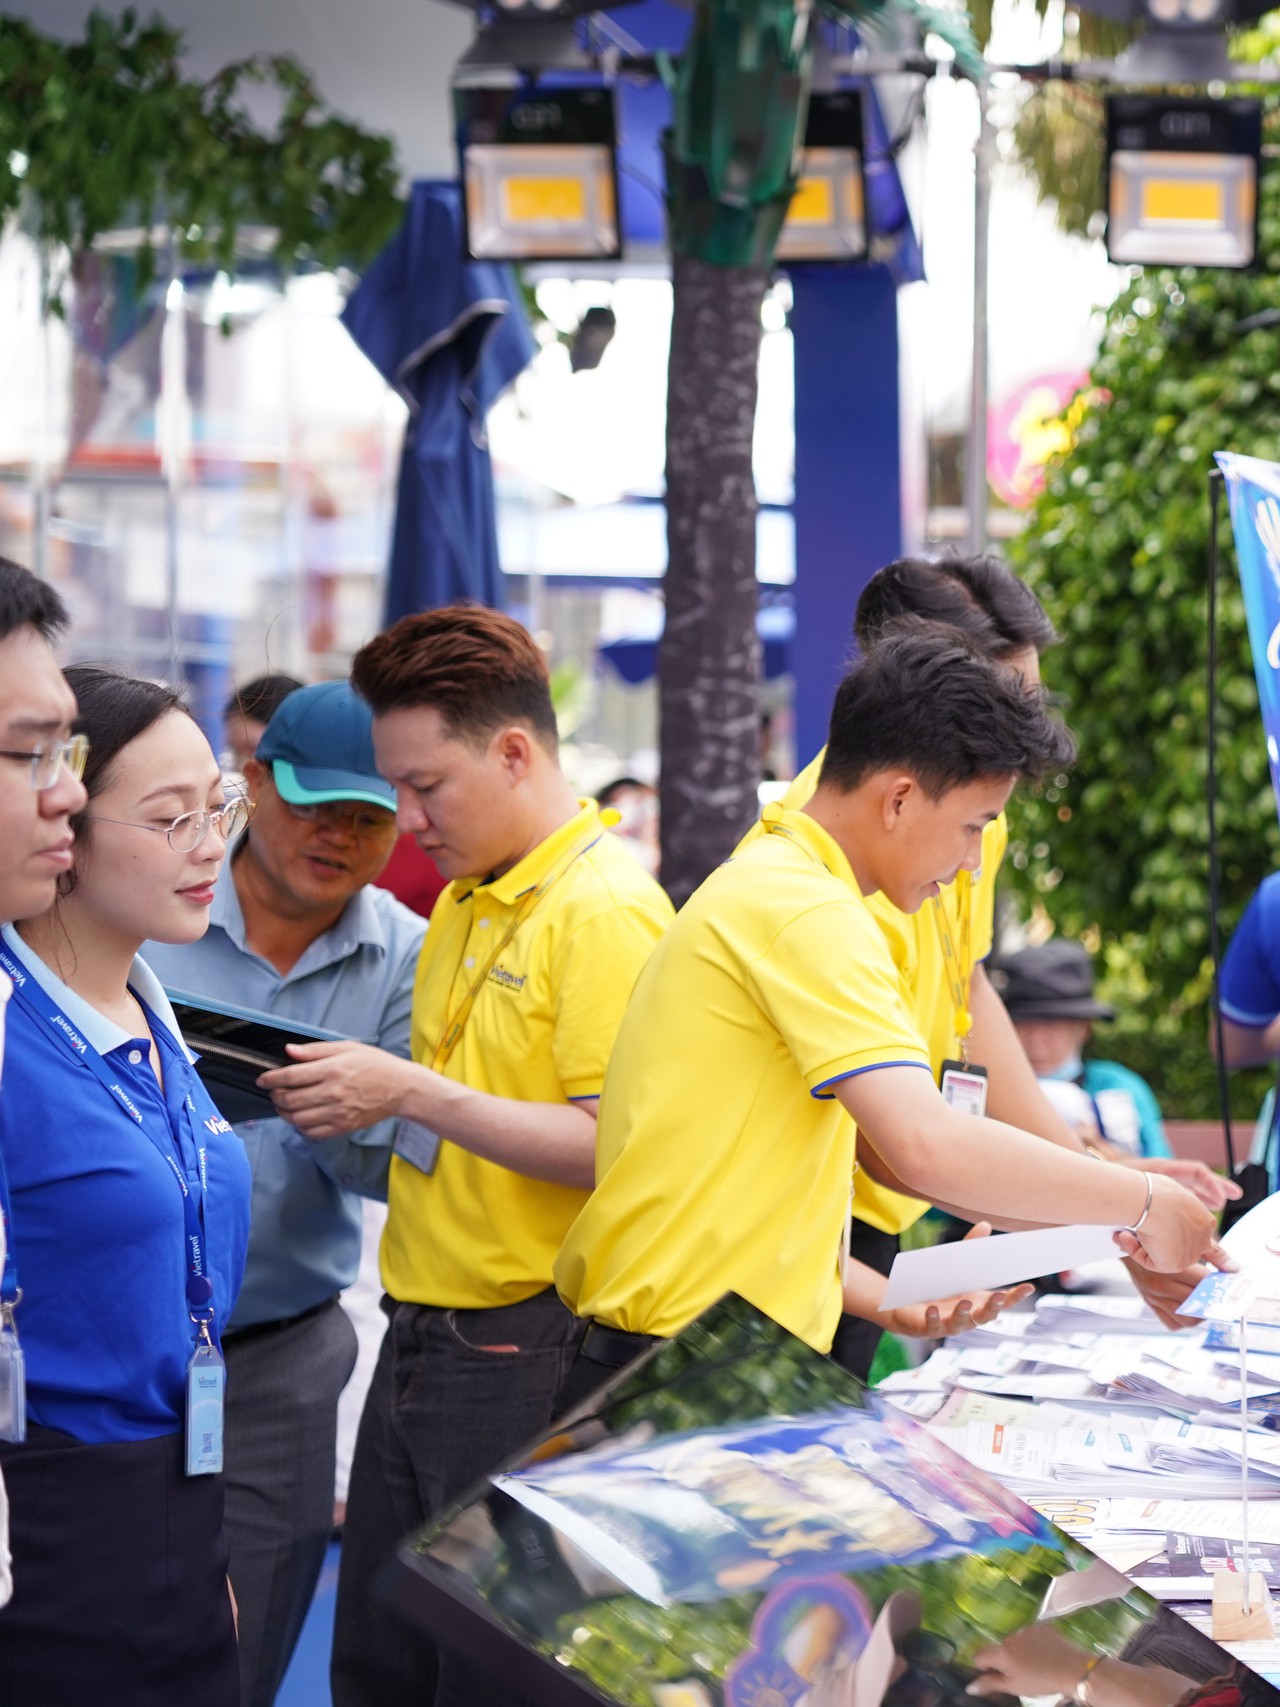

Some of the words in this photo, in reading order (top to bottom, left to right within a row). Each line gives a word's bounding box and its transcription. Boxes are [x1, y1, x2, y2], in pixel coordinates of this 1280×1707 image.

[51, 1015, 88, 1054] Vietravel
[111, 1084, 143, 1123] Vietravel
[189, 1235, 202, 1277] Vietravel
